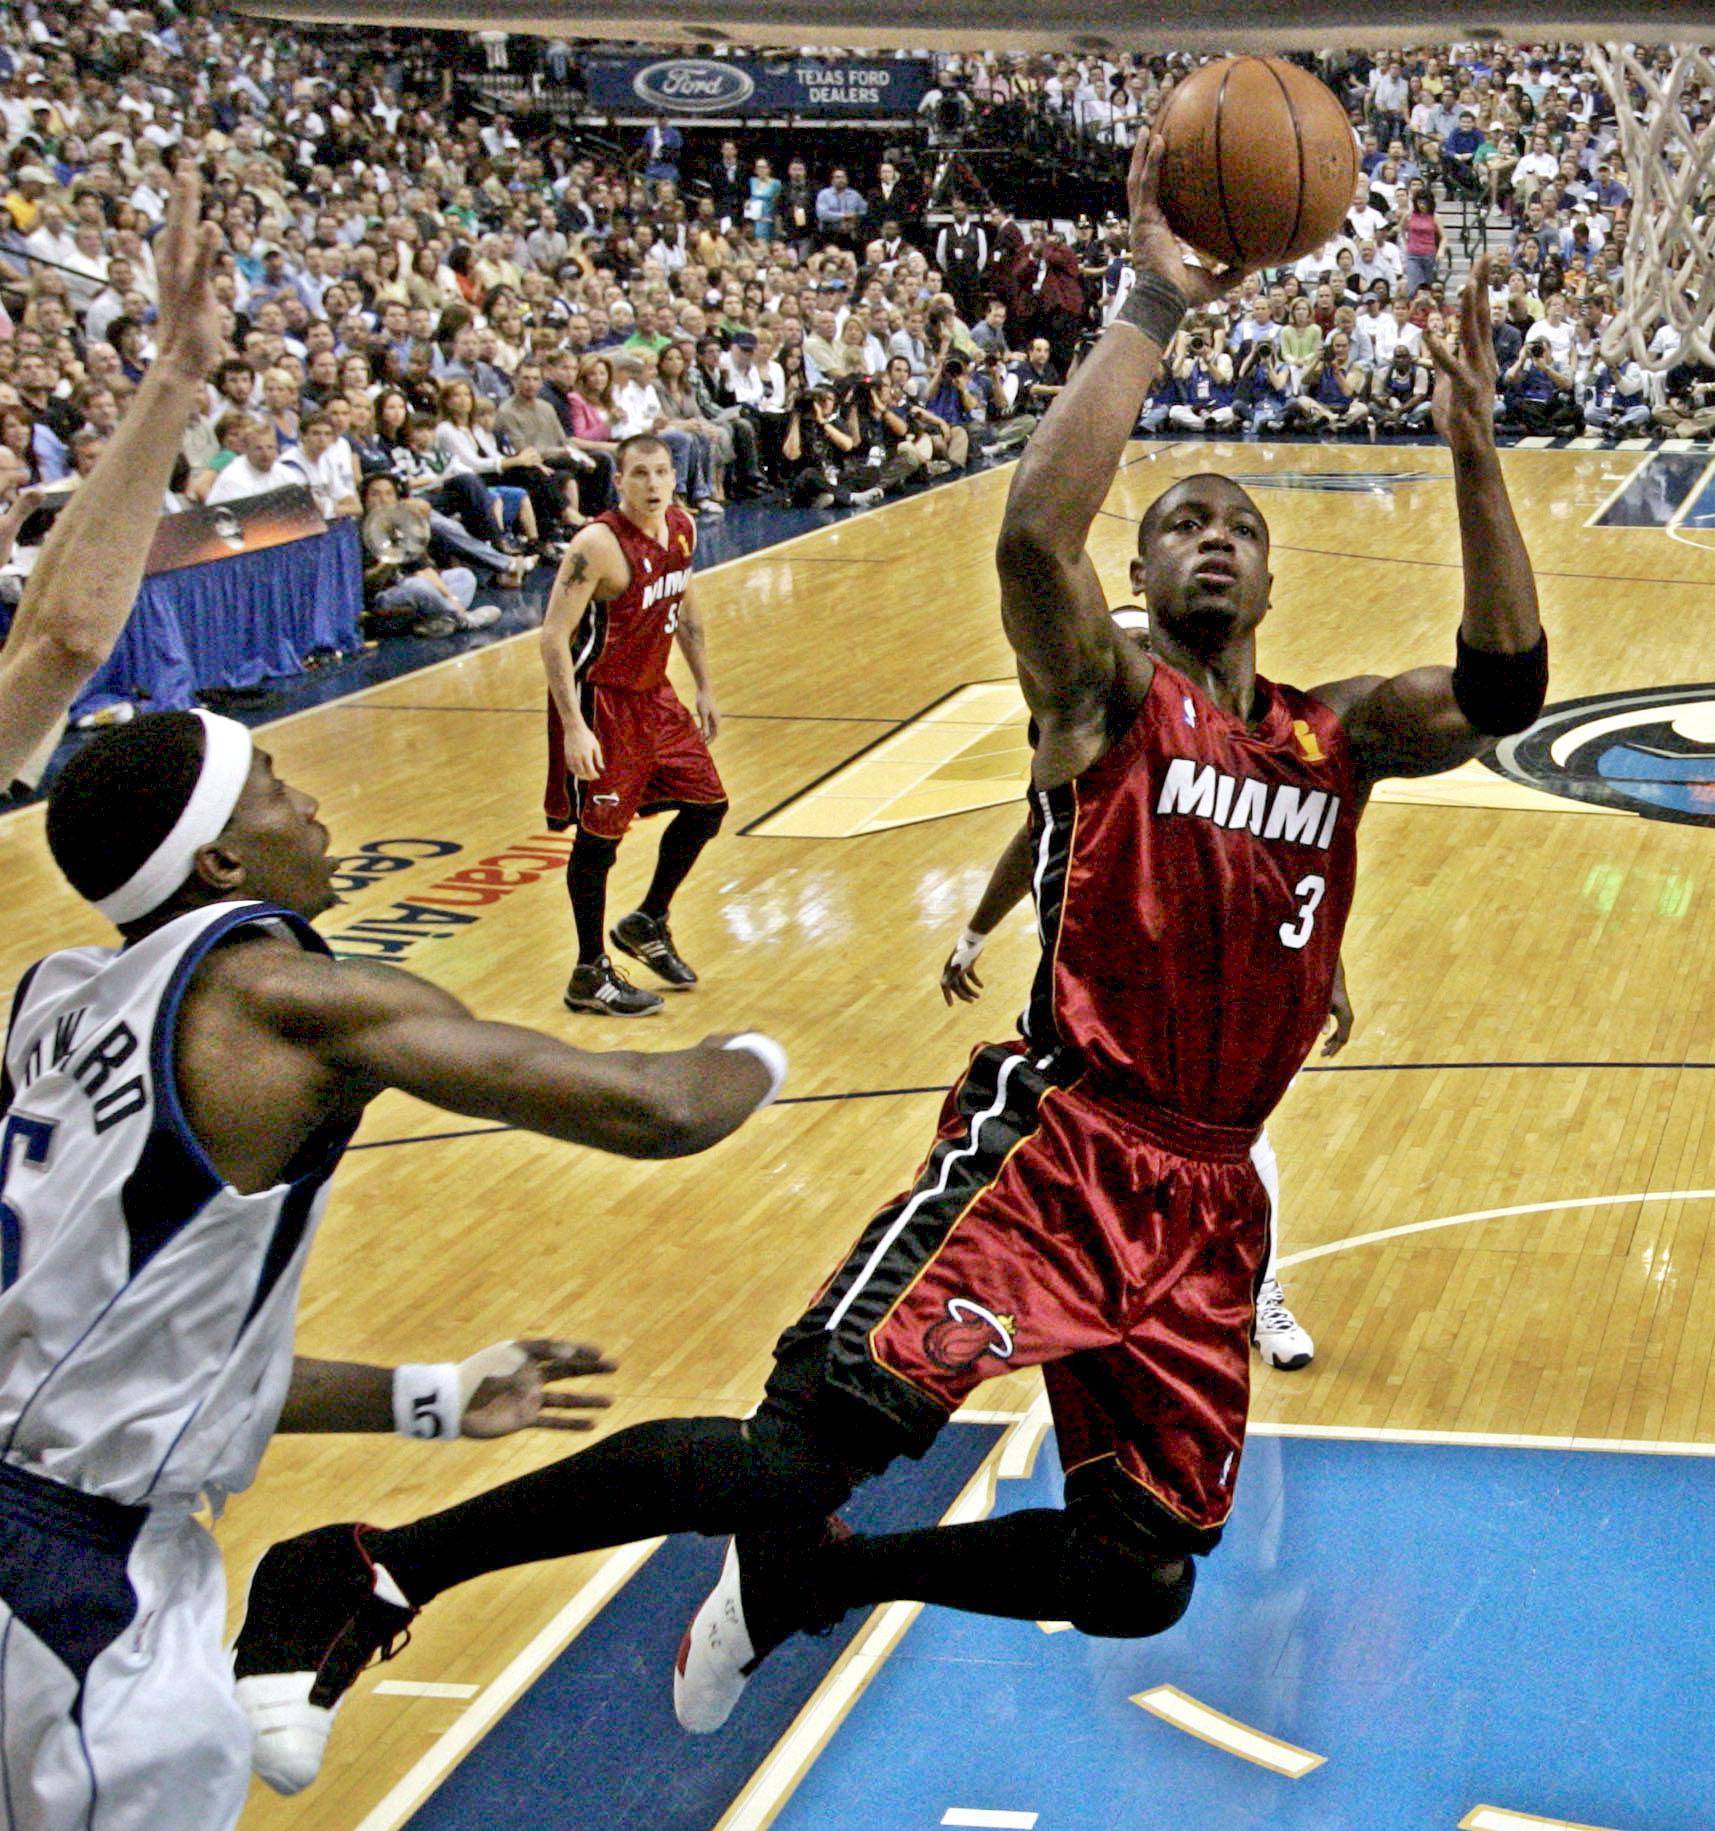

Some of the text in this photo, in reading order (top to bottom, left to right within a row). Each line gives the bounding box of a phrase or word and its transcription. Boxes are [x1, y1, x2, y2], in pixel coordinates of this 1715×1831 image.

[662, 68, 722, 96] Ford
[796, 69, 891, 87] TEXAS FORD
[809, 87, 880, 104] DEALERS
[1156, 758, 1341, 850] MIAMI
[1278, 874, 1326, 949] 3
[412, 1392, 442, 1440] 5
